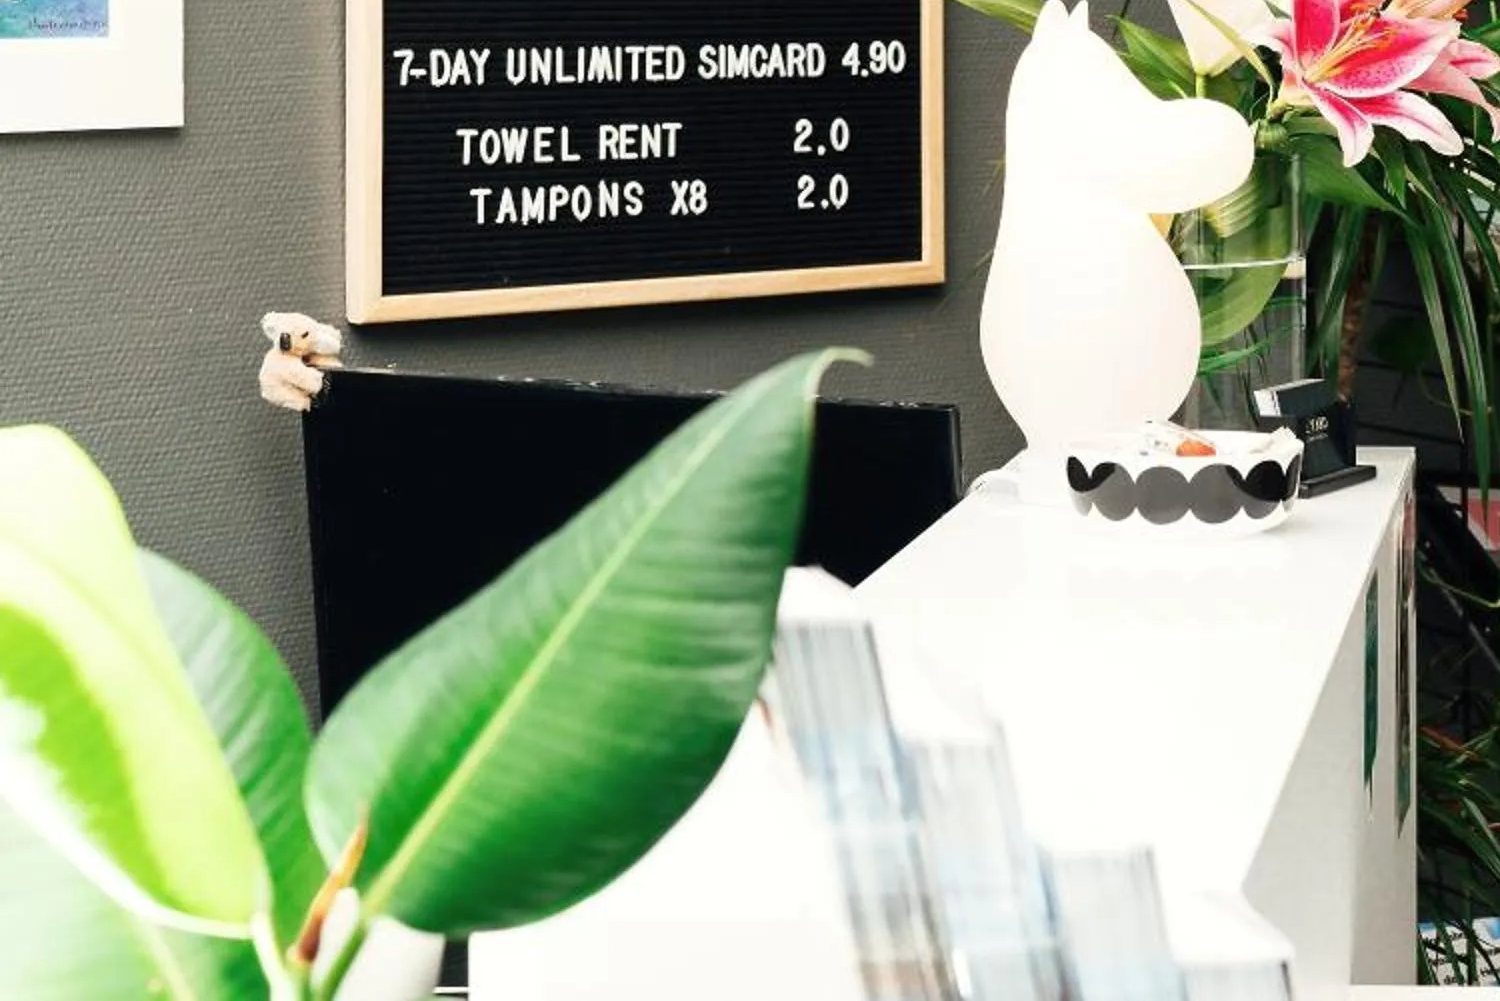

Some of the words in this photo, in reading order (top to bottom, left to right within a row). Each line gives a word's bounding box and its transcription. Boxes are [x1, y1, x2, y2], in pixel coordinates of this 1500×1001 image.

[393, 48, 491, 87] 7-DAY
[506, 44, 686, 85] UNLIMITED
[697, 42, 826, 79] SIMCARD
[841, 39, 907, 77] 4.90
[456, 126, 581, 166] TOWEL
[598, 122, 683, 161] RENT
[470, 180, 644, 225] TAMPONS
[670, 179, 708, 215] X8
[797, 173, 849, 210] 2.0
